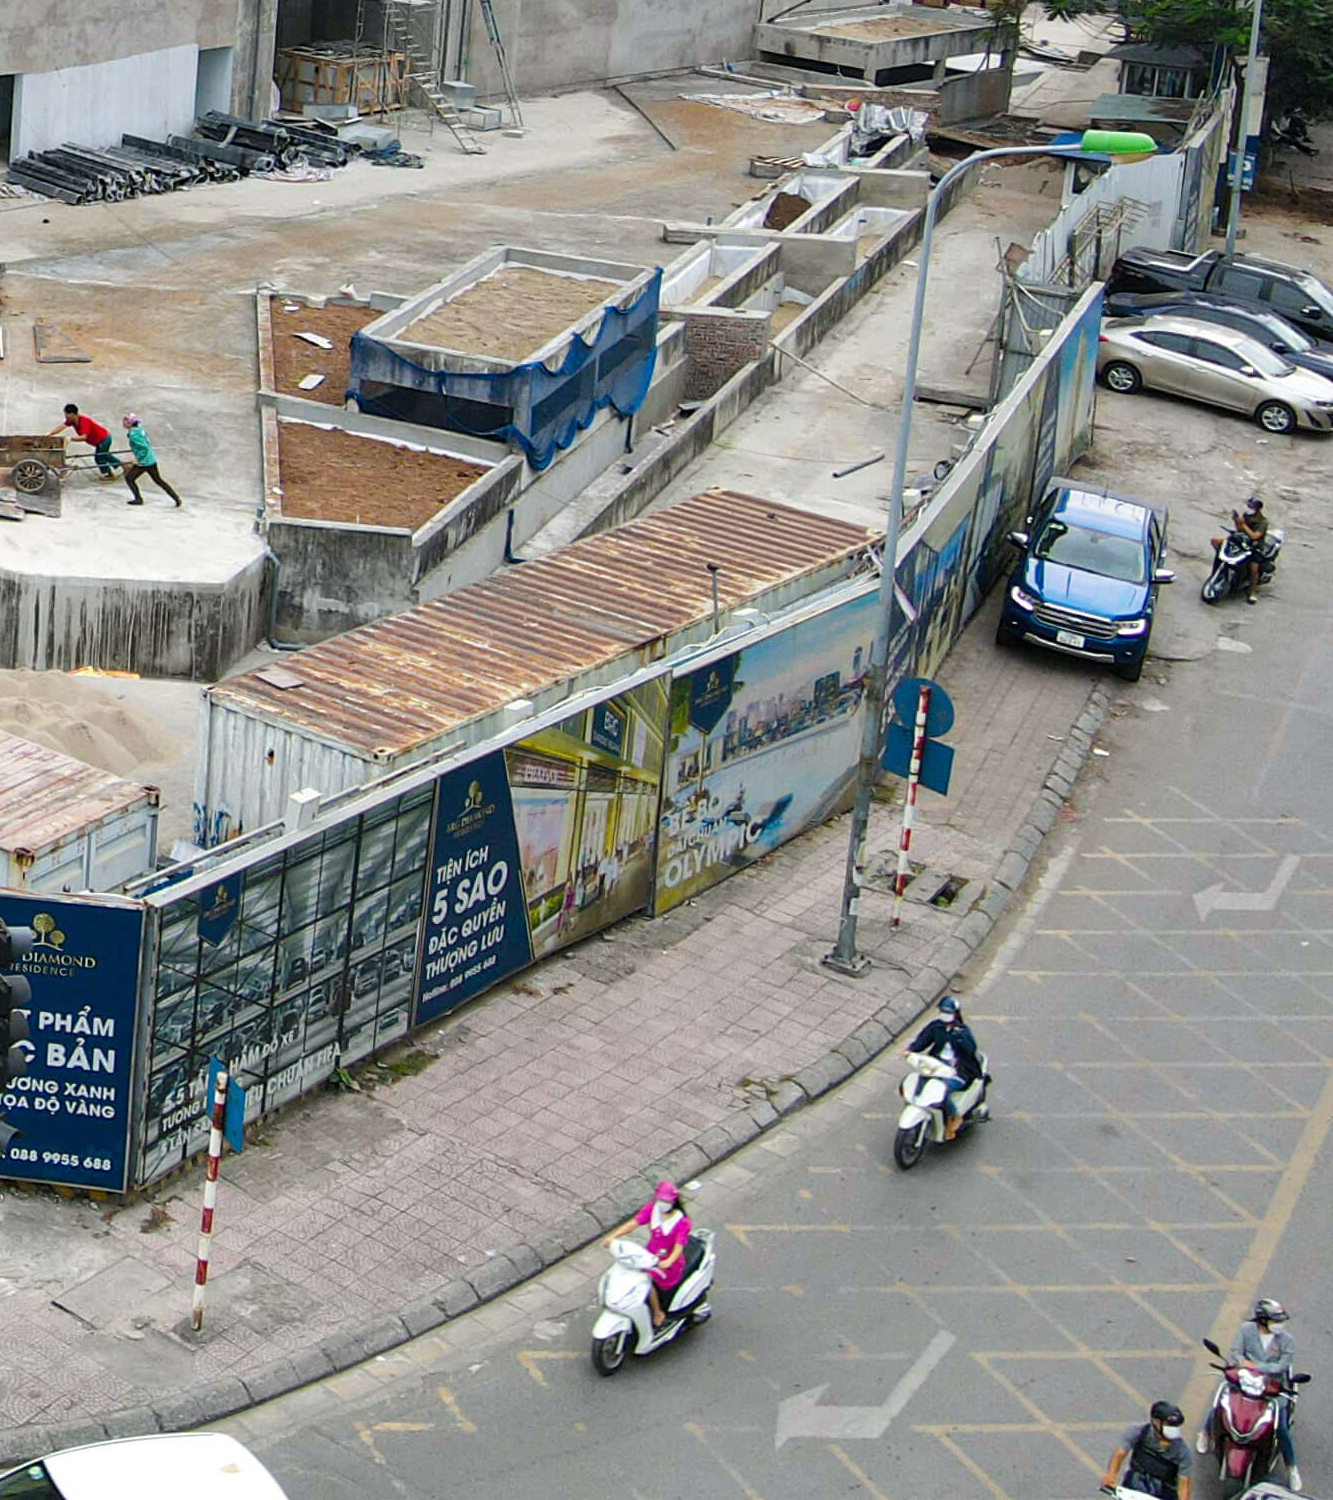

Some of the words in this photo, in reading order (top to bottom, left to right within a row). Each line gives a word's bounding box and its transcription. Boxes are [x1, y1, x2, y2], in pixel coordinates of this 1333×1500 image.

[437, 857, 462, 884] TIỆN
[464, 845, 488, 872] ÍCH
[664, 820, 762, 889] OLYMPIC
[432, 889, 448, 924] 5
[454, 860, 508, 914] SAO
[429, 924, 458, 955] ĐẶC
[461, 897, 506, 938] QUYỀN
[22, 952, 97, 970] DIAMOND
[426, 939, 478, 980] THƯỢNG
[481, 924, 504, 949] LƯU
[38, 1005, 115, 1038] PHẨM
[47, 1038, 116, 1073] BẢN
[34, 1092, 61, 1115] ĐỘ
[65, 1099, 116, 1119] VÀNG
[64, 1082, 116, 1101] XANH
[10, 1148, 37, 1162] 088
[42, 1151, 79, 1167] 9955
[83, 1154, 111, 1171] 688
